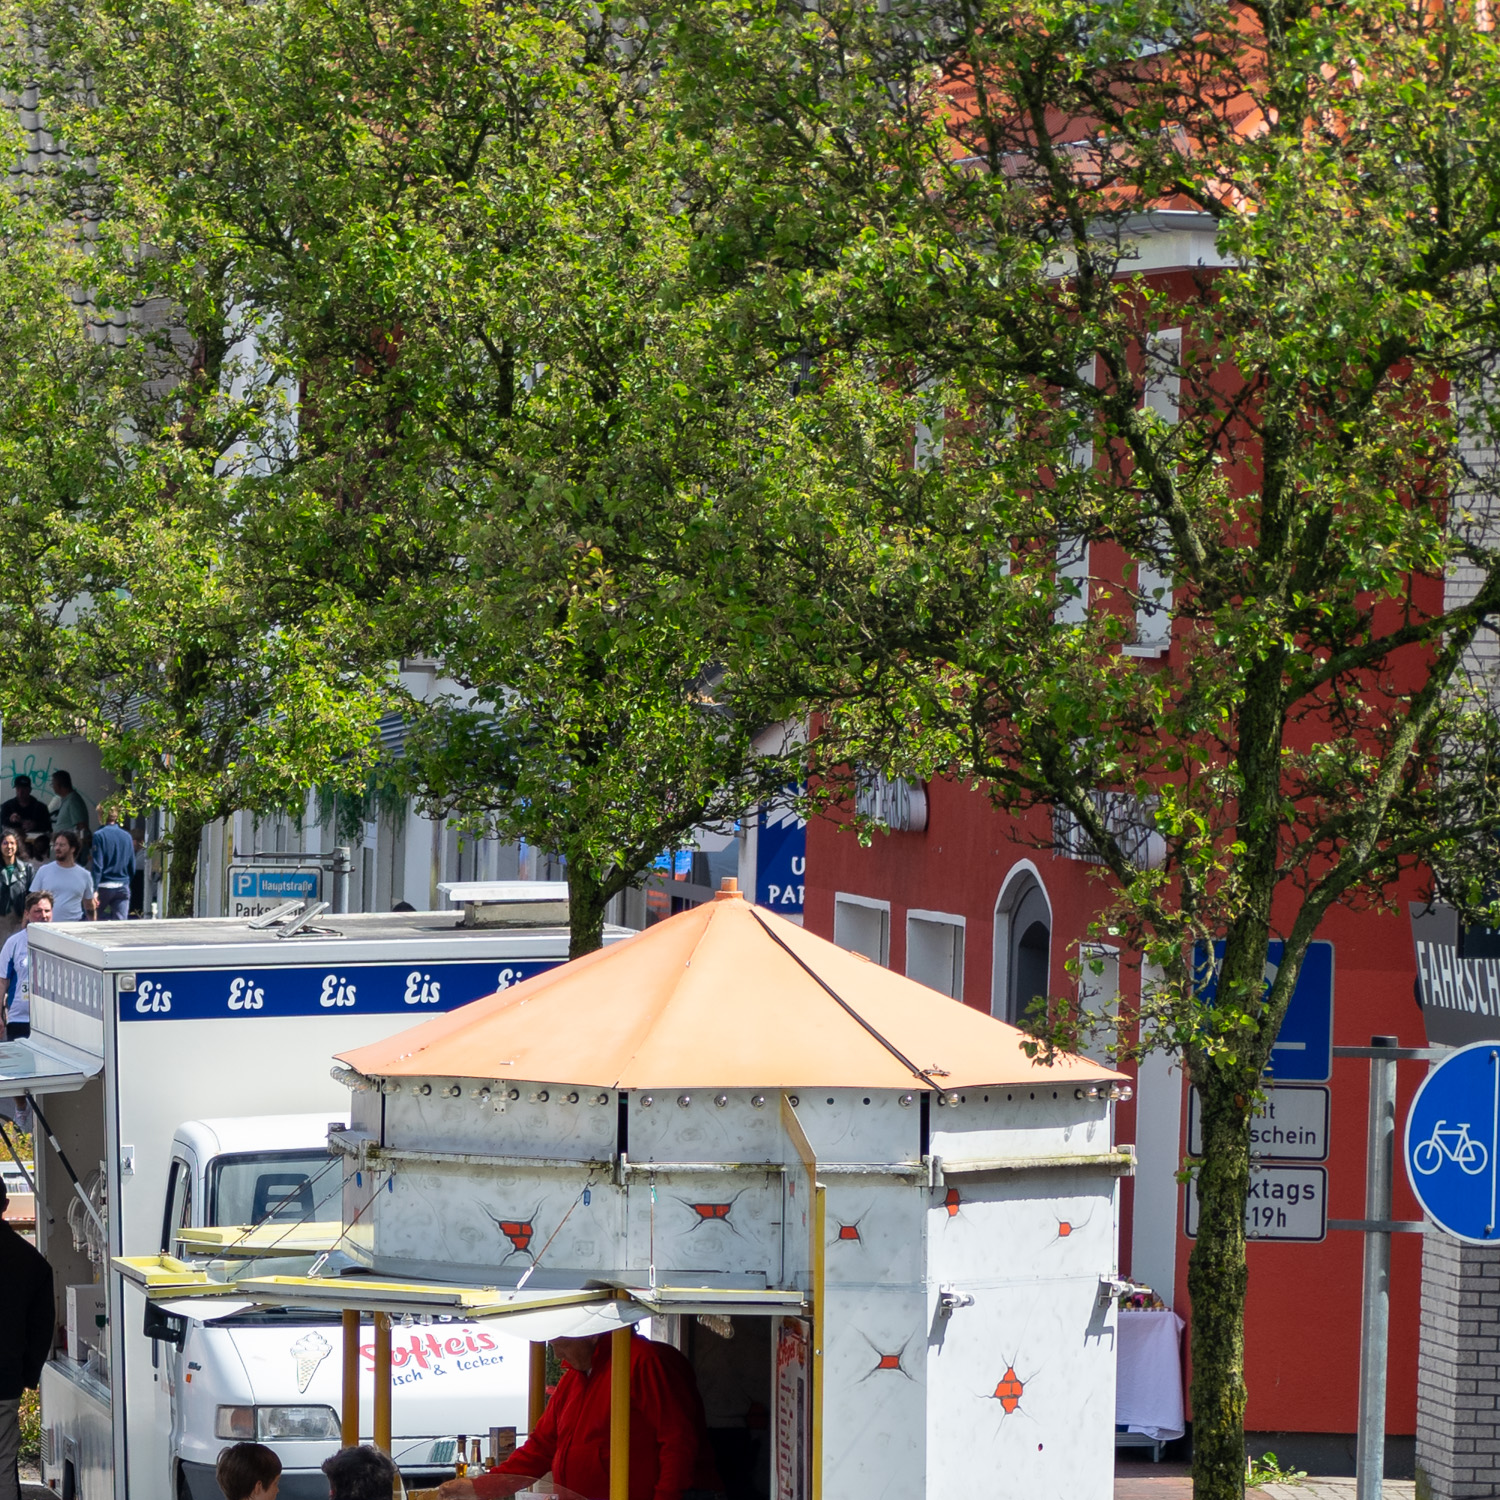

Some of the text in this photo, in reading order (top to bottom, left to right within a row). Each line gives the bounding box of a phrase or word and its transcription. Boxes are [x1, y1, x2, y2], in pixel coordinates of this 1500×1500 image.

[791, 856, 806, 875] U
[238, 875, 313, 894] P Hauptstraße
[228, 977, 264, 1011] Eis
[320, 974, 356, 1008] Eis
[404, 971, 441, 1004] Eis
[496, 968, 524, 994] Ei
[1416, 940, 1500, 1017] FAHRSCH
[136, 980, 172, 1014] Eis
[1249, 1126, 1316, 1145] schein
[1248, 1177, 1316, 1206] ktags
[359, 1328, 498, 1371] Softeis
[392, 1354, 505, 1387] isch & lecker
